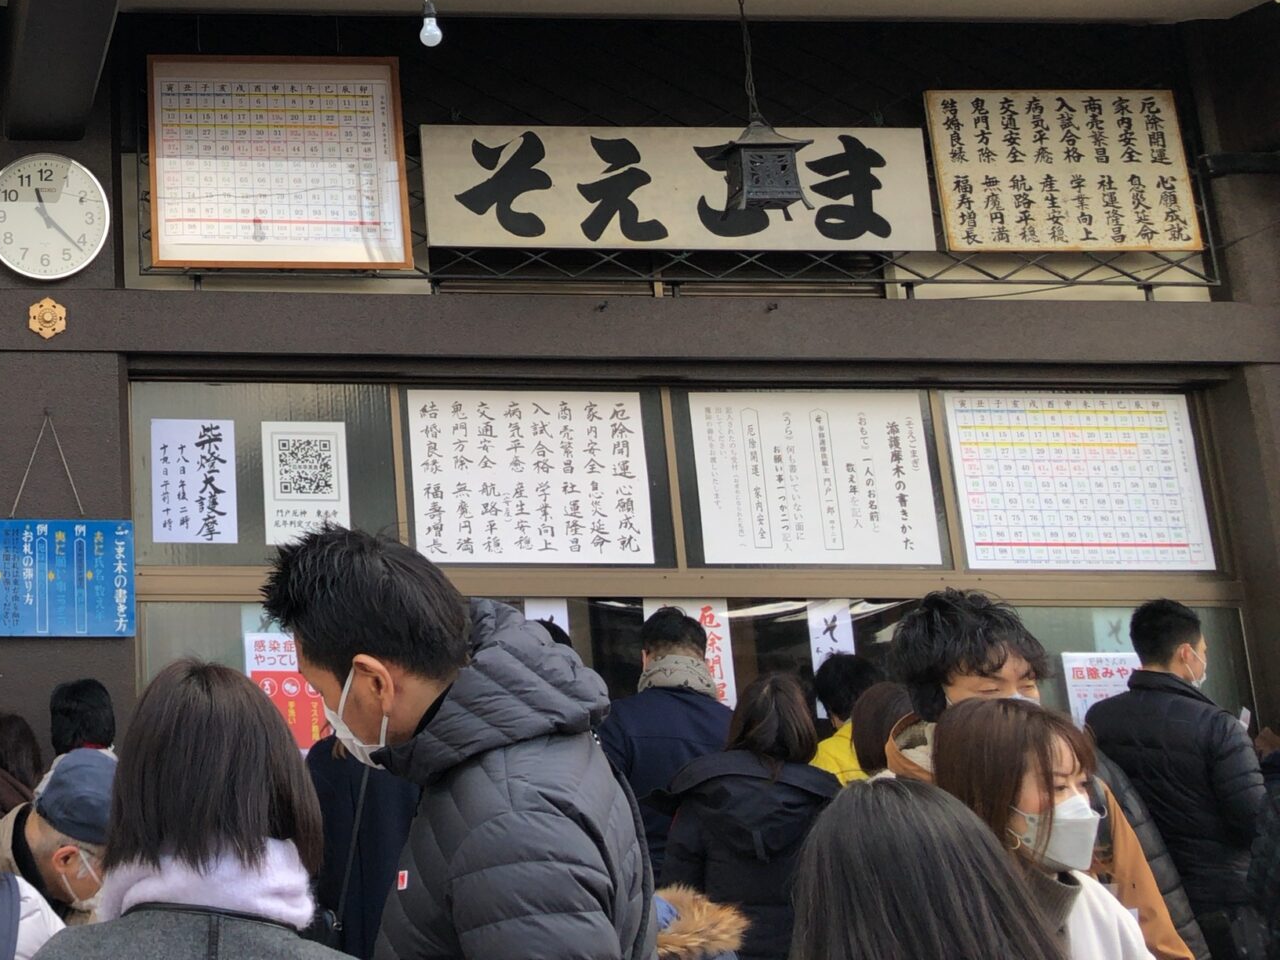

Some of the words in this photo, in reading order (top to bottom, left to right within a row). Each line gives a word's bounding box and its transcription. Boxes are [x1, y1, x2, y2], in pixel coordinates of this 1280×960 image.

[941, 99, 969, 163] 結婚良縁
[970, 97, 998, 163] 鬼門方除
[1000, 97, 1026, 163] 交通安全
[1056, 97, 1085, 163] 入試合格
[1140, 97, 1173, 165] 厄除開運
[1, 189, 18, 202] 10
[18, 174, 31, 187] 11
[37, 169, 53, 181] 12
[1025, 96, 1053, 164] 病気平癒
[1039, 174, 1068, 243] 産生安穏
[1081, 96, 1110, 163] 商売繁昌
[1097, 175, 1127, 243] 社運隆昌
[1112, 97, 1143, 163] 家内安全
[1128, 175, 1159, 245] 息災延命
[3, 232, 13, 245] 8
[85, 212, 94, 225] 3
[953, 175, 983, 245] 福寿増長
[982, 175, 1010, 242] 無魔円満
[1009, 175, 1041, 243] 航路平穏
[1070, 174, 1098, 241] 学業向上
[1156, 175, 1192, 242] 心願成就
[20, 248, 29, 260] 7
[40, 254, 50, 266] 6
[62, 249, 71, 261] 5
[1072, 667, 1137, 679] 厄除みや
